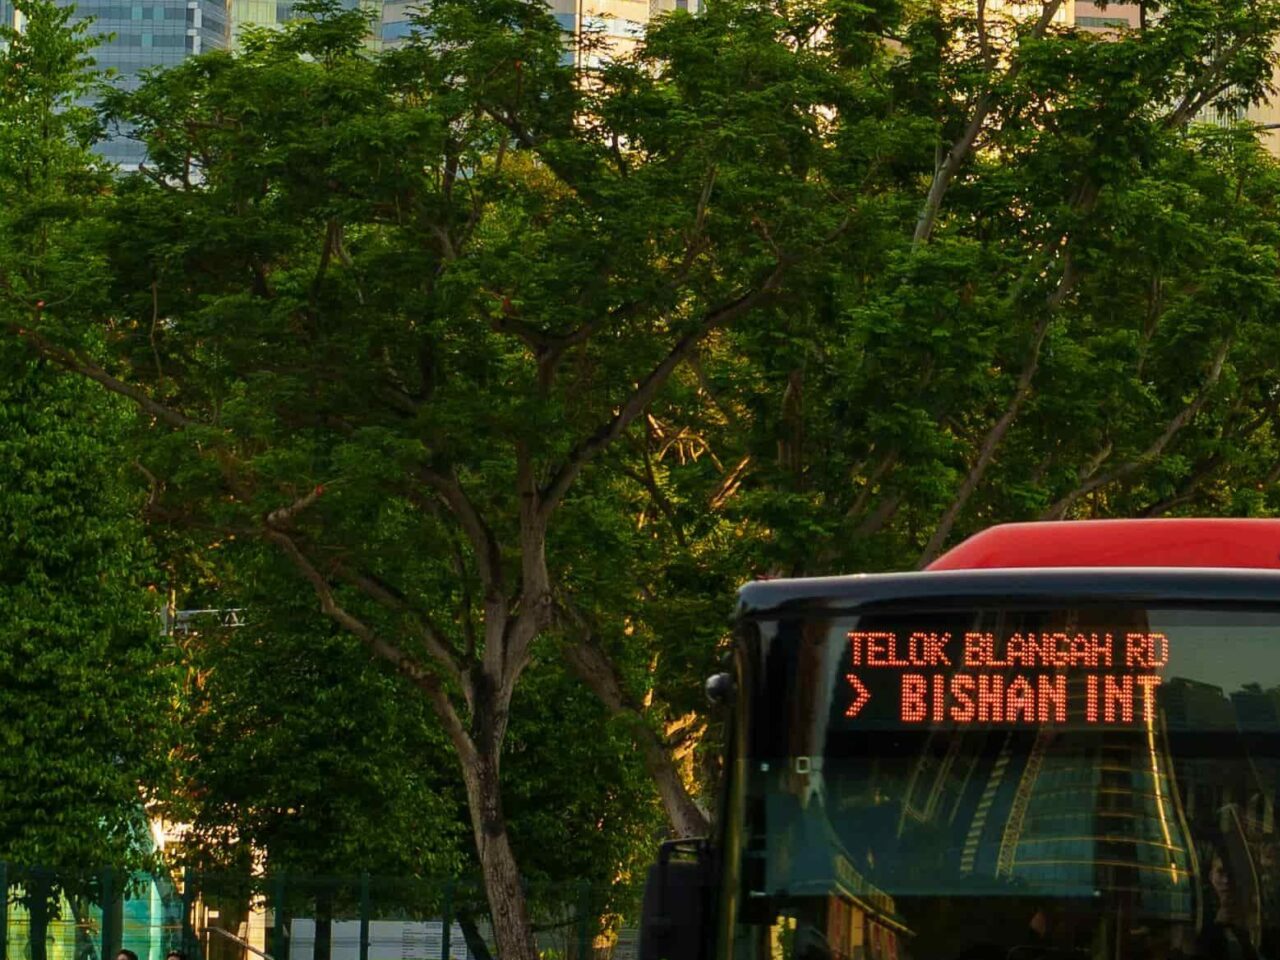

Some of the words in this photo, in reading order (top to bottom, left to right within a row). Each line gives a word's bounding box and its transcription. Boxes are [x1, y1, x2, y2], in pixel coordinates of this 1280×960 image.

[847, 632, 952, 667] TELOK
[965, 632, 1113, 667] BLANGAH
[1126, 632, 1170, 667] RD
[901, 673, 1067, 722] BISHAN
[1087, 674, 1162, 722] INT
